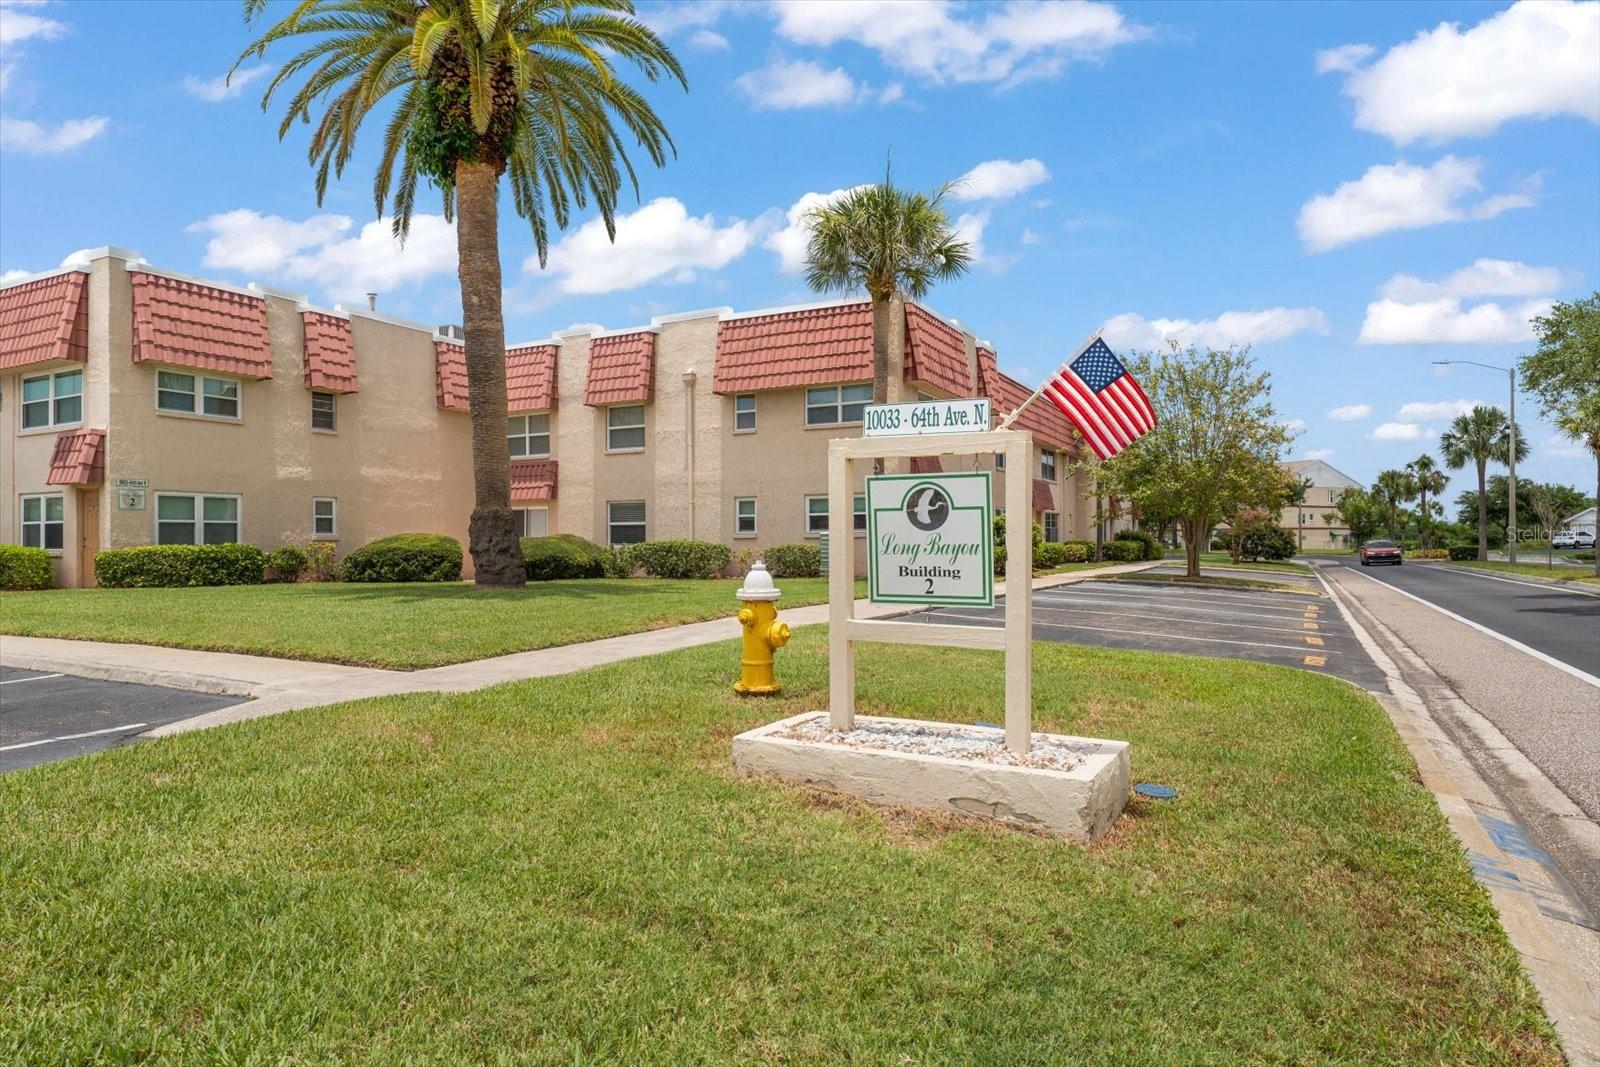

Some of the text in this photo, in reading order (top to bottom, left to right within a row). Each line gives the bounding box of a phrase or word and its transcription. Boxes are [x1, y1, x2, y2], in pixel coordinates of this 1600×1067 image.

[866, 409, 901, 430] 10033
[911, 406, 940, 428] 64th
[943, 405, 970, 427] Ave.
[973, 403, 987, 425] N.
[880, 532, 980, 567] Long Bayou
[898, 565, 962, 580] Building
[924, 578, 935, 595] 2
